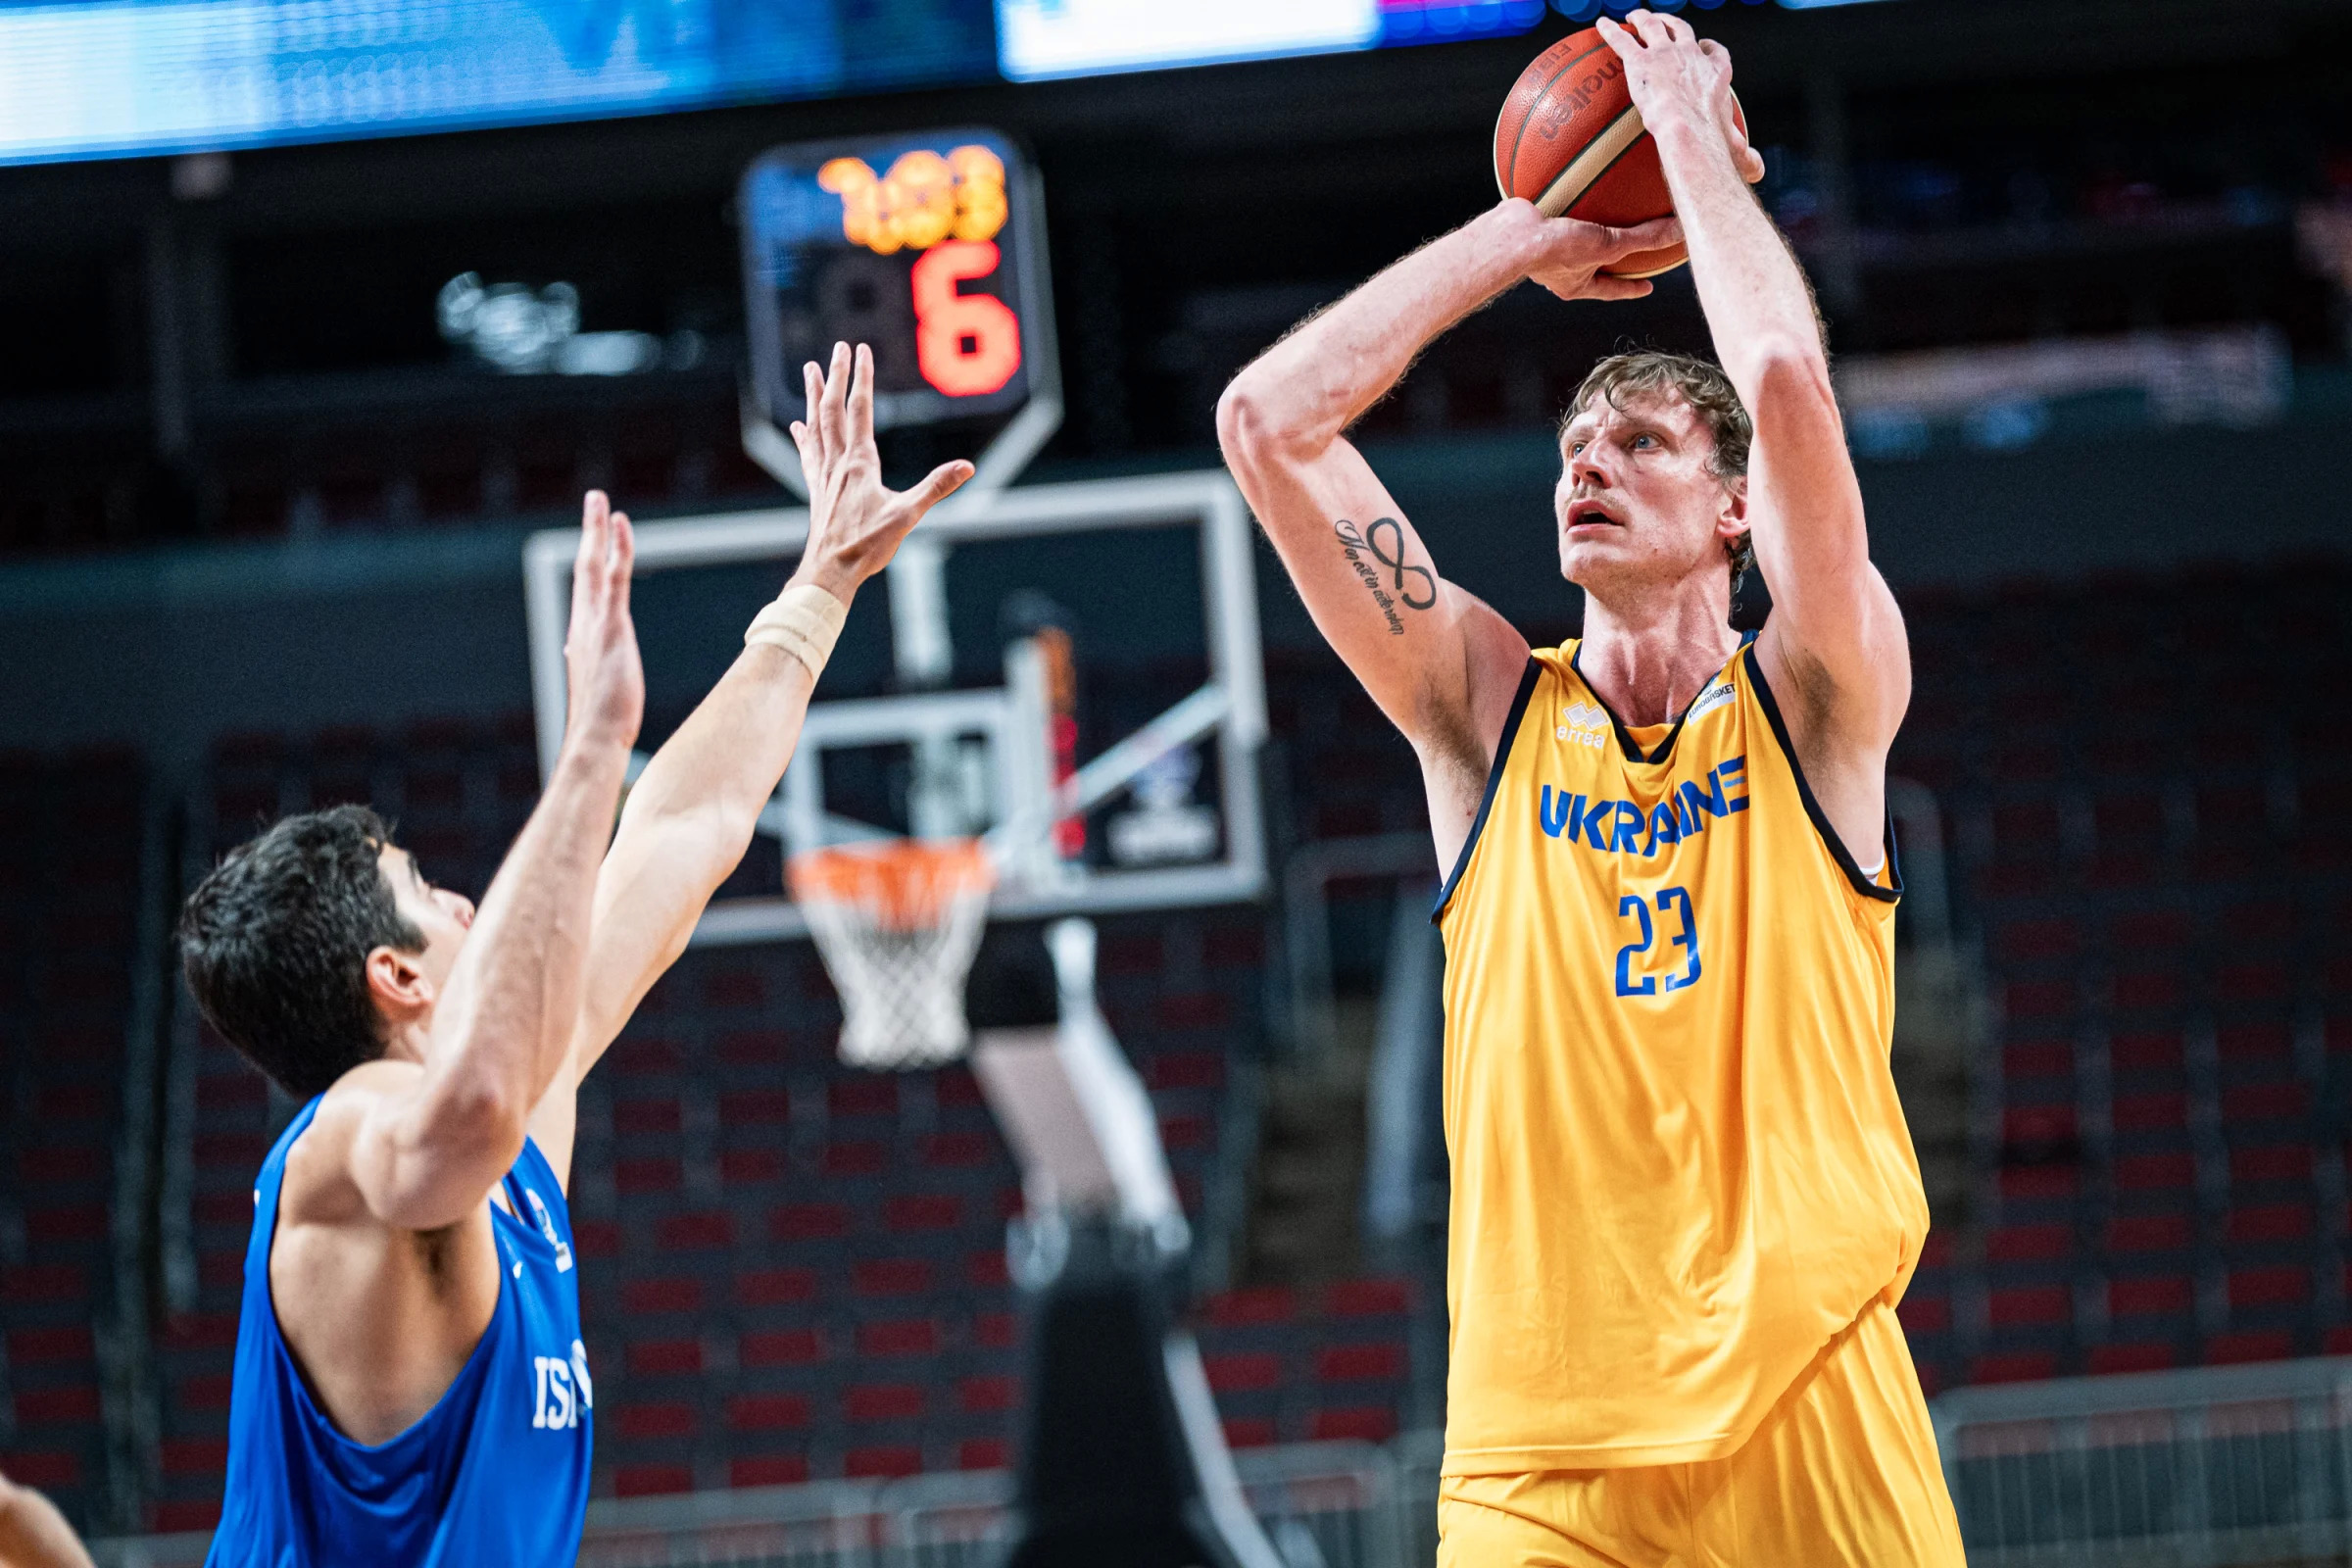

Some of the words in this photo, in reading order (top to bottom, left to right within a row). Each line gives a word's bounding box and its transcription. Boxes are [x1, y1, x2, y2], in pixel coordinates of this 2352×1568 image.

[911, 239, 1021, 397] 6
[1540, 755, 1750, 858] UKRAINE
[1615, 886, 1702, 998] 23
